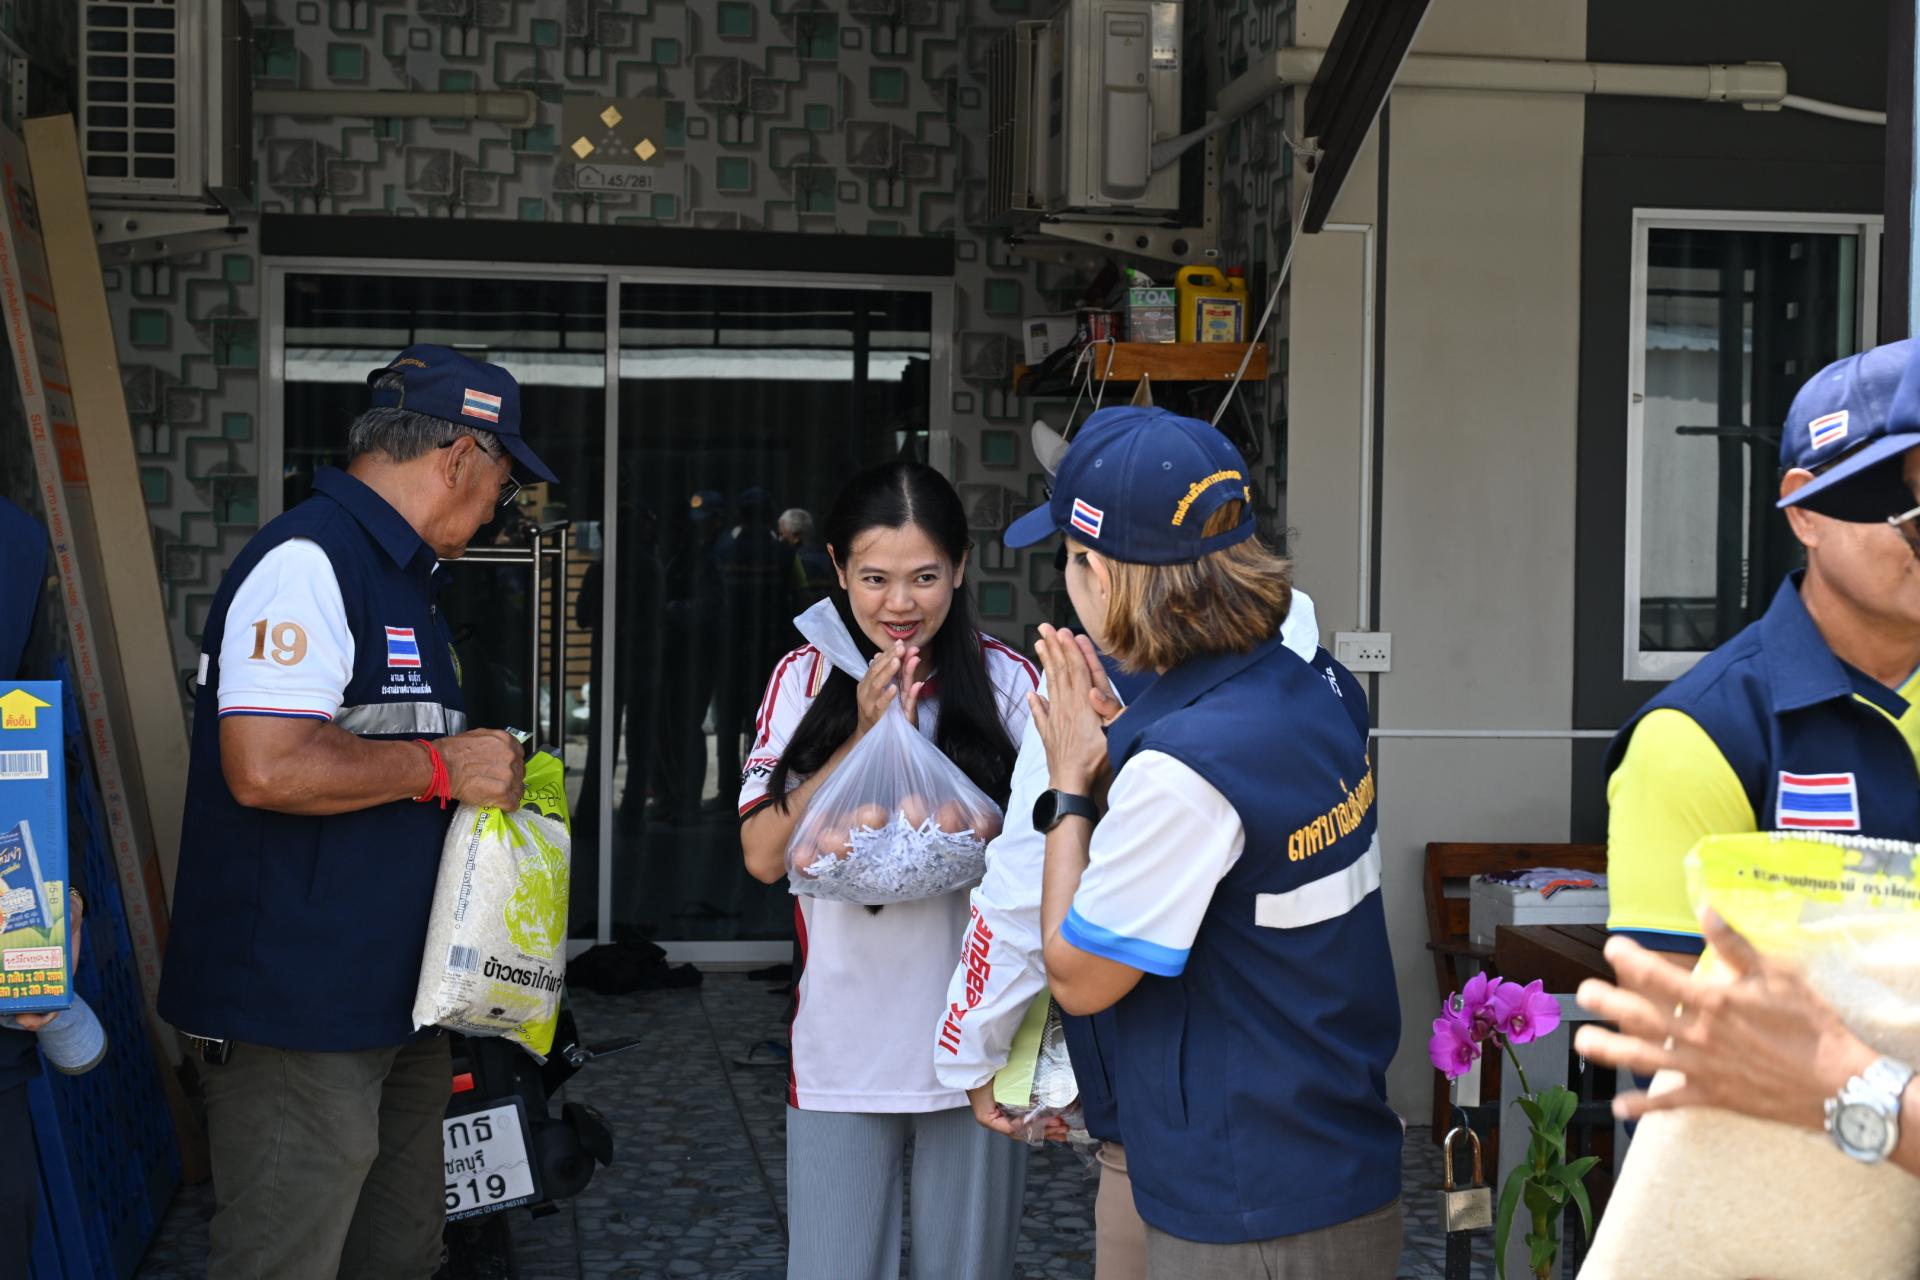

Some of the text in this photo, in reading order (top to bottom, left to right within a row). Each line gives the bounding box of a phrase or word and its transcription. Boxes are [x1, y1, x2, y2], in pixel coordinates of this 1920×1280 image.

[1136, 290, 1171, 304] TOA
[30, 412, 46, 442] SIZE
[248, 618, 308, 666] 19
[445, 1149, 485, 1174] ชลบุรี
[445, 1173, 506, 1210] 519
